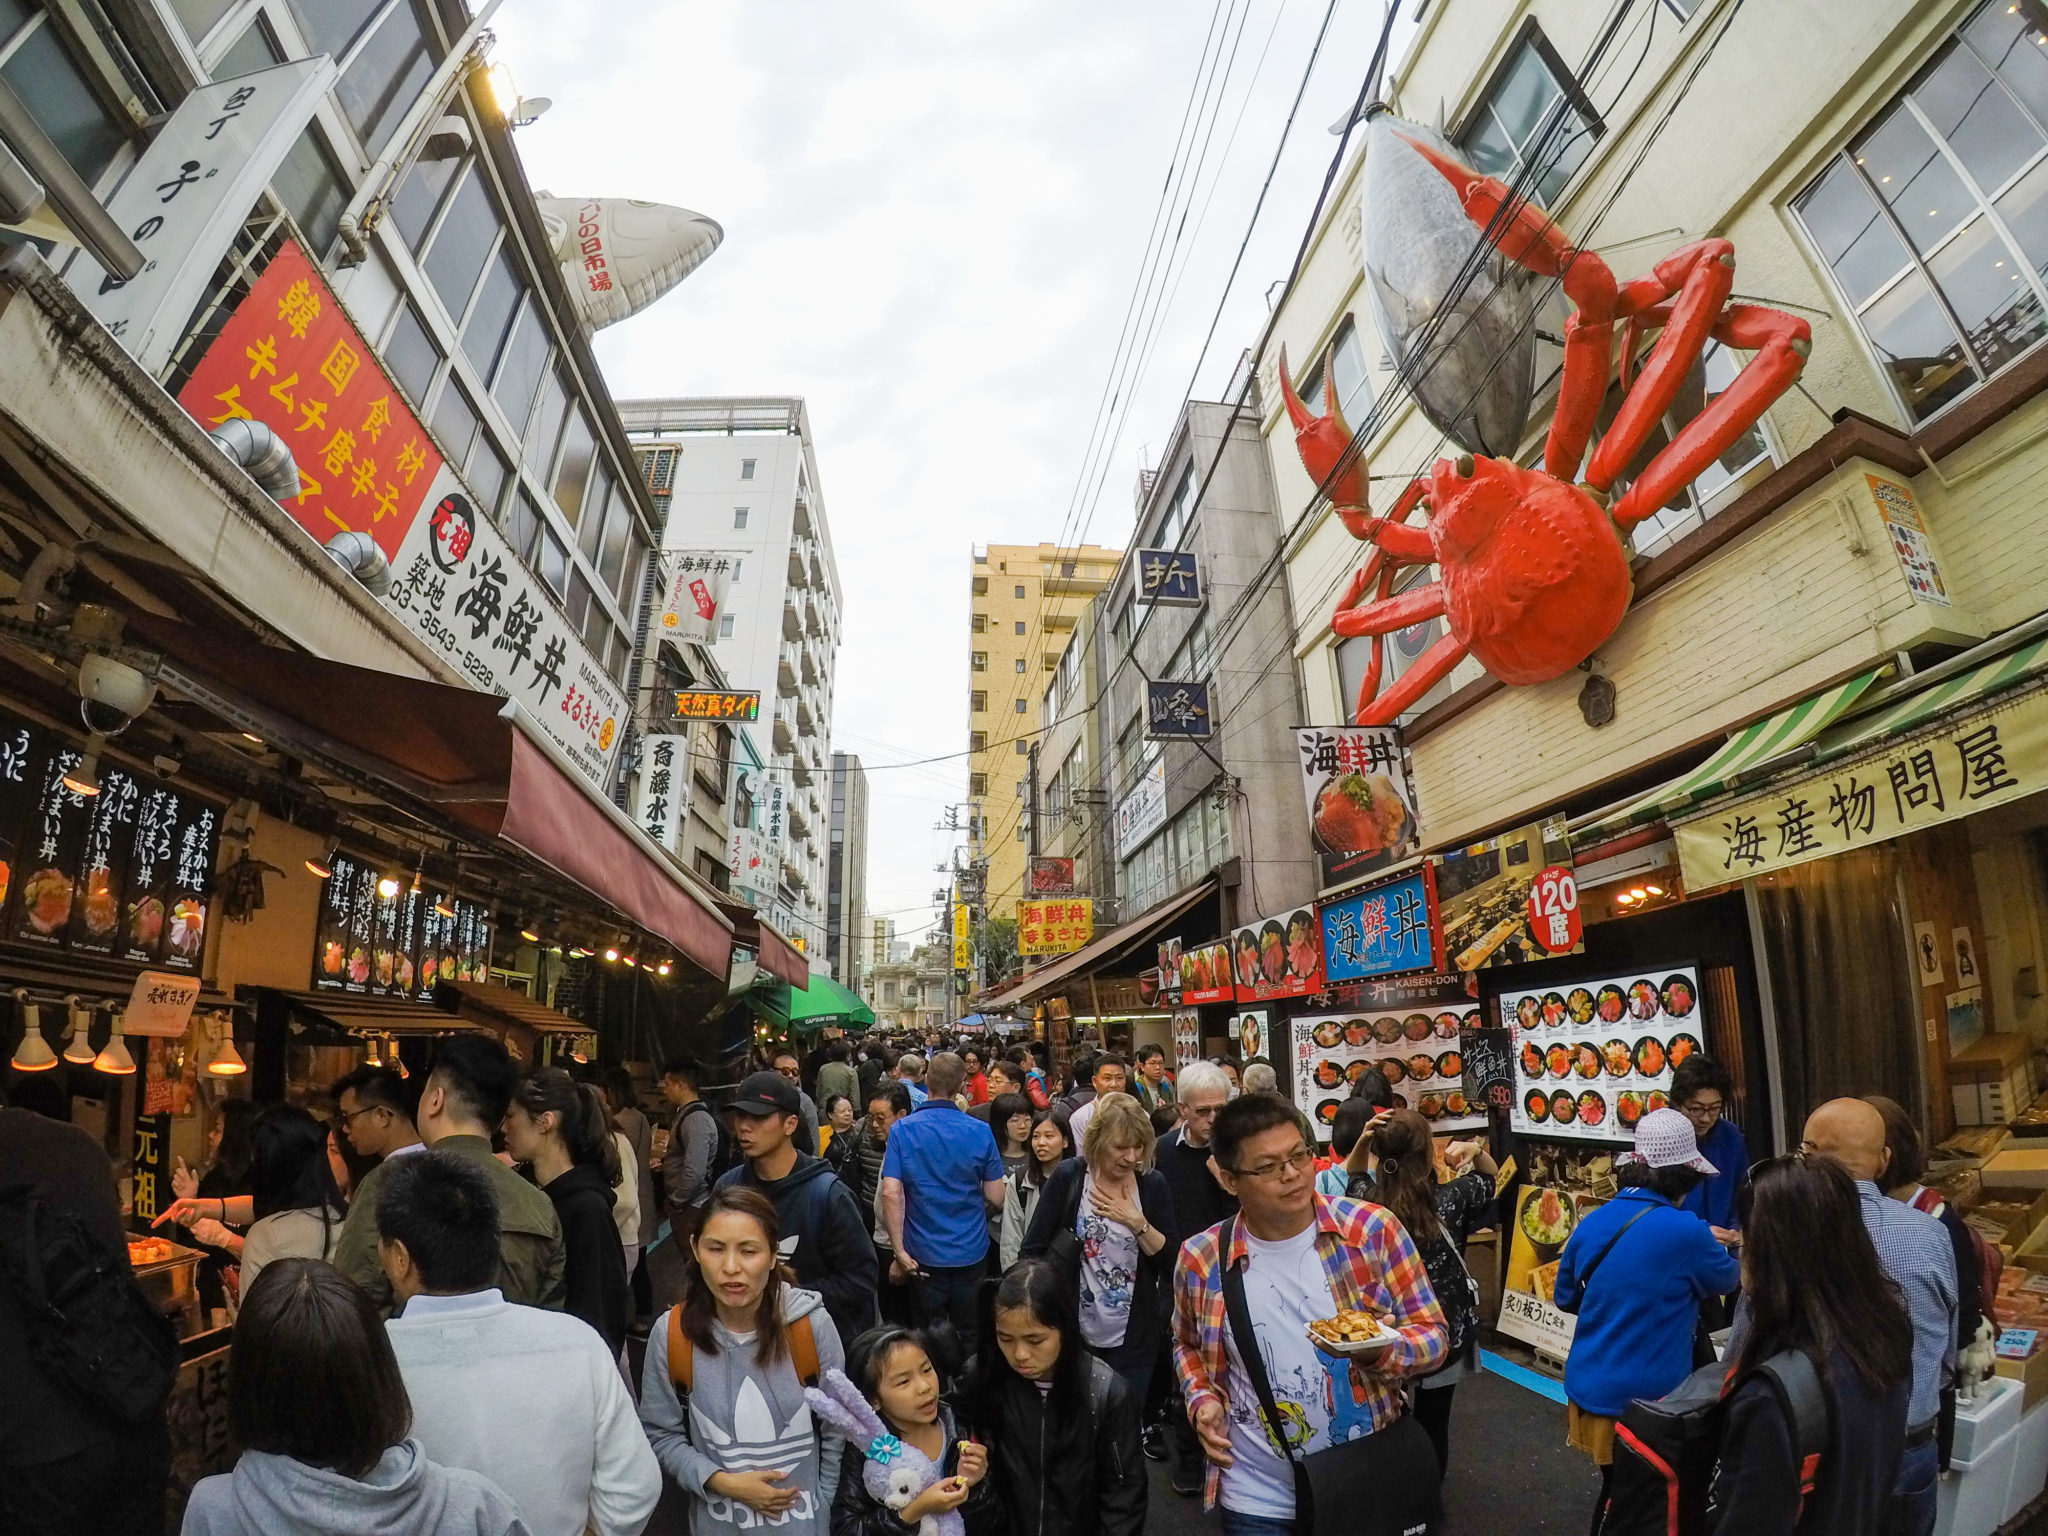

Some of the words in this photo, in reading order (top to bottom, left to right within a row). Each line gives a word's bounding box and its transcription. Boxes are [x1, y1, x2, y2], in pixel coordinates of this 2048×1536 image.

[277, 278, 427, 486] 韓国食材
[245, 334, 400, 523] キムチ唐辛子
[428, 499, 474, 563] 元祖
[404, 551, 446, 612] 築地
[455, 548, 567, 706] 海鮮丼
[561, 682, 601, 740] まるきた
[1300, 731, 1398, 778] 海鮮丼
[91, 770, 124, 876] ざんまい丼
[117, 777, 139, 823] かに
[158, 795, 179, 860] まぐろ
[1721, 725, 2019, 870] 海産物問屋
[137, 788, 167, 889] ざんまい丼
[175, 824, 199, 888] 産直丼
[1024, 904, 1086, 926] 海鮮丼
[1530, 875, 1577, 918] 120
[1024, 926, 1087, 944] まるきた
[1026, 943, 1068, 954] MARUKITA
[1330, 888, 1427, 968] 海鮮丼
[1548, 912, 1569, 946] 席
[1395, 975, 1458, 988] KAISEN-DON
[1294, 1024, 1315, 1077] 海鮮丼
[133, 1115, 159, 1222] 元祖
